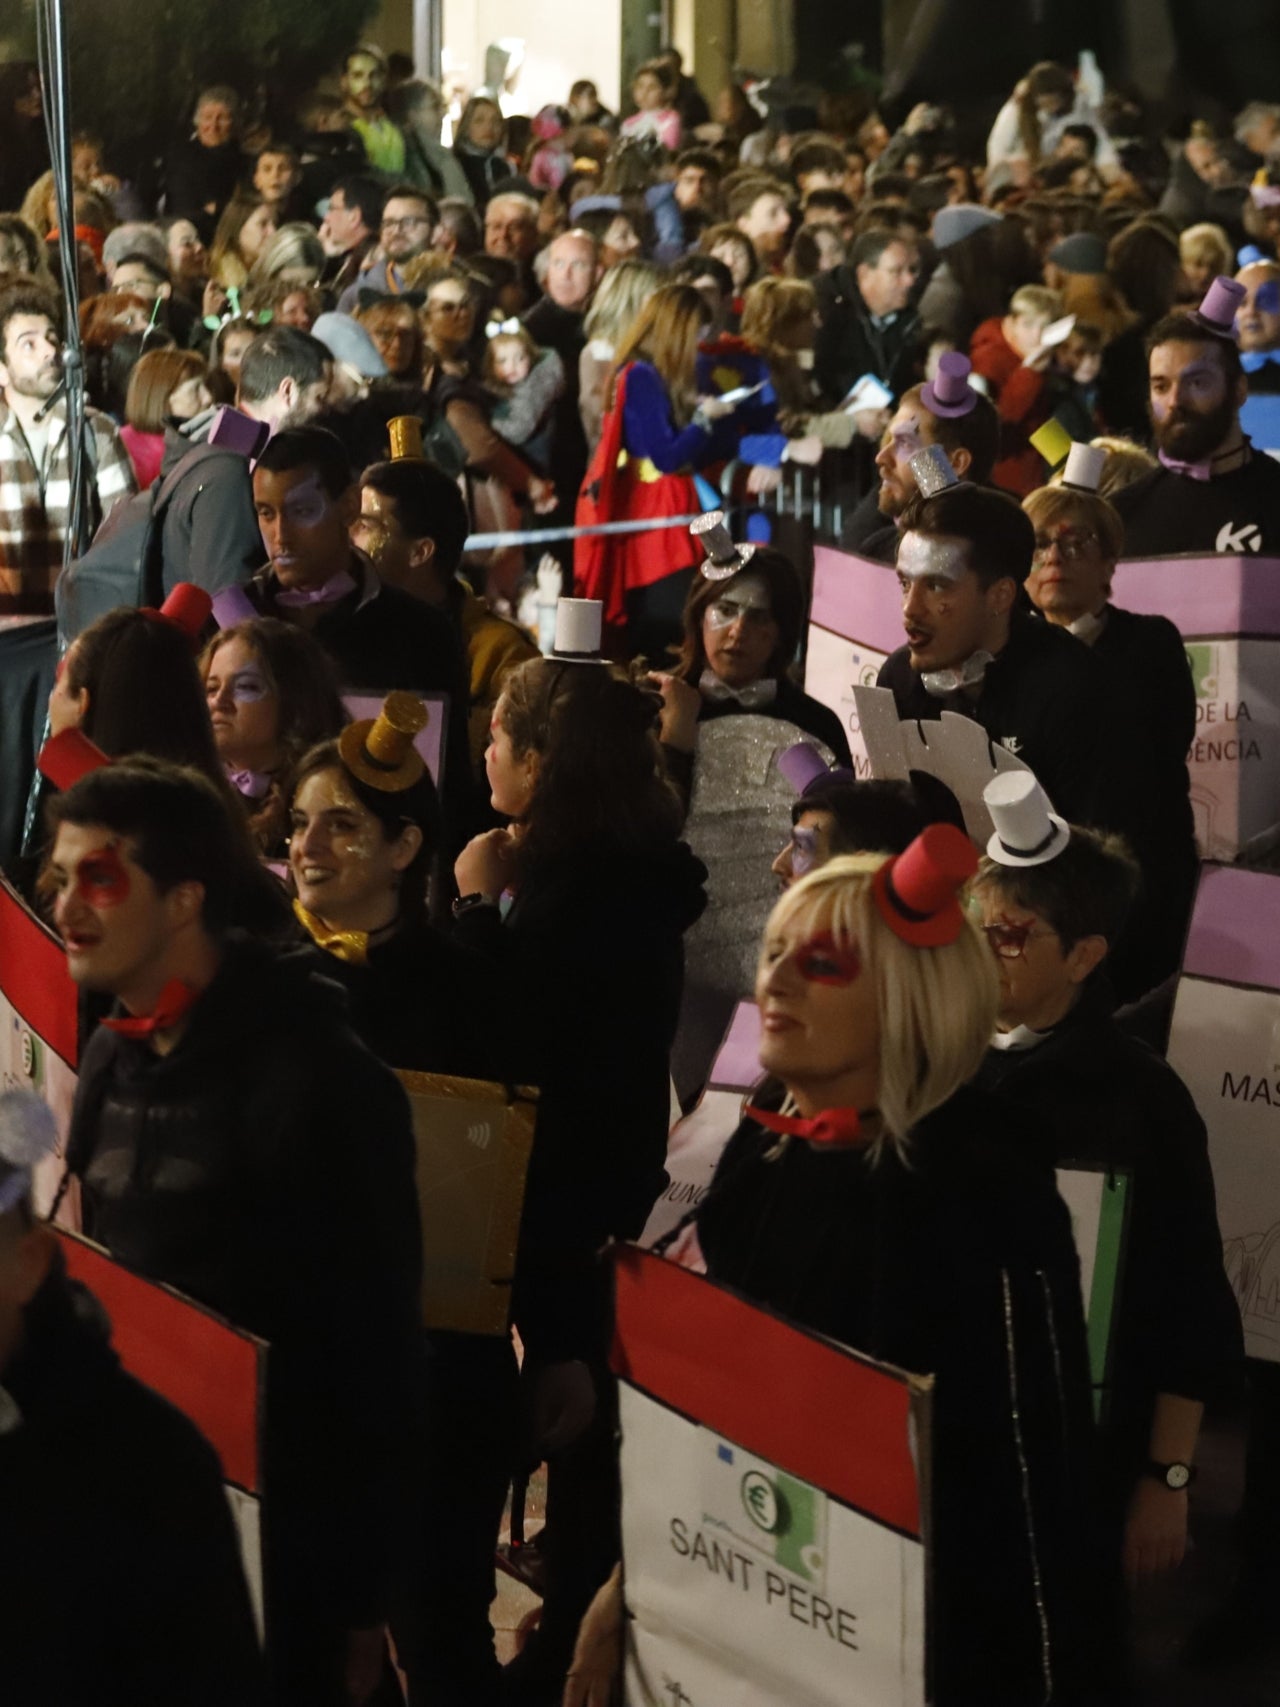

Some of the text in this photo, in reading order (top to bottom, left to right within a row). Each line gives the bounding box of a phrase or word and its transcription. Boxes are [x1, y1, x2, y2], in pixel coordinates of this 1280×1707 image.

[1224, 701, 1252, 721] LA
[670, 1517, 860, 1652] SANT PERE
